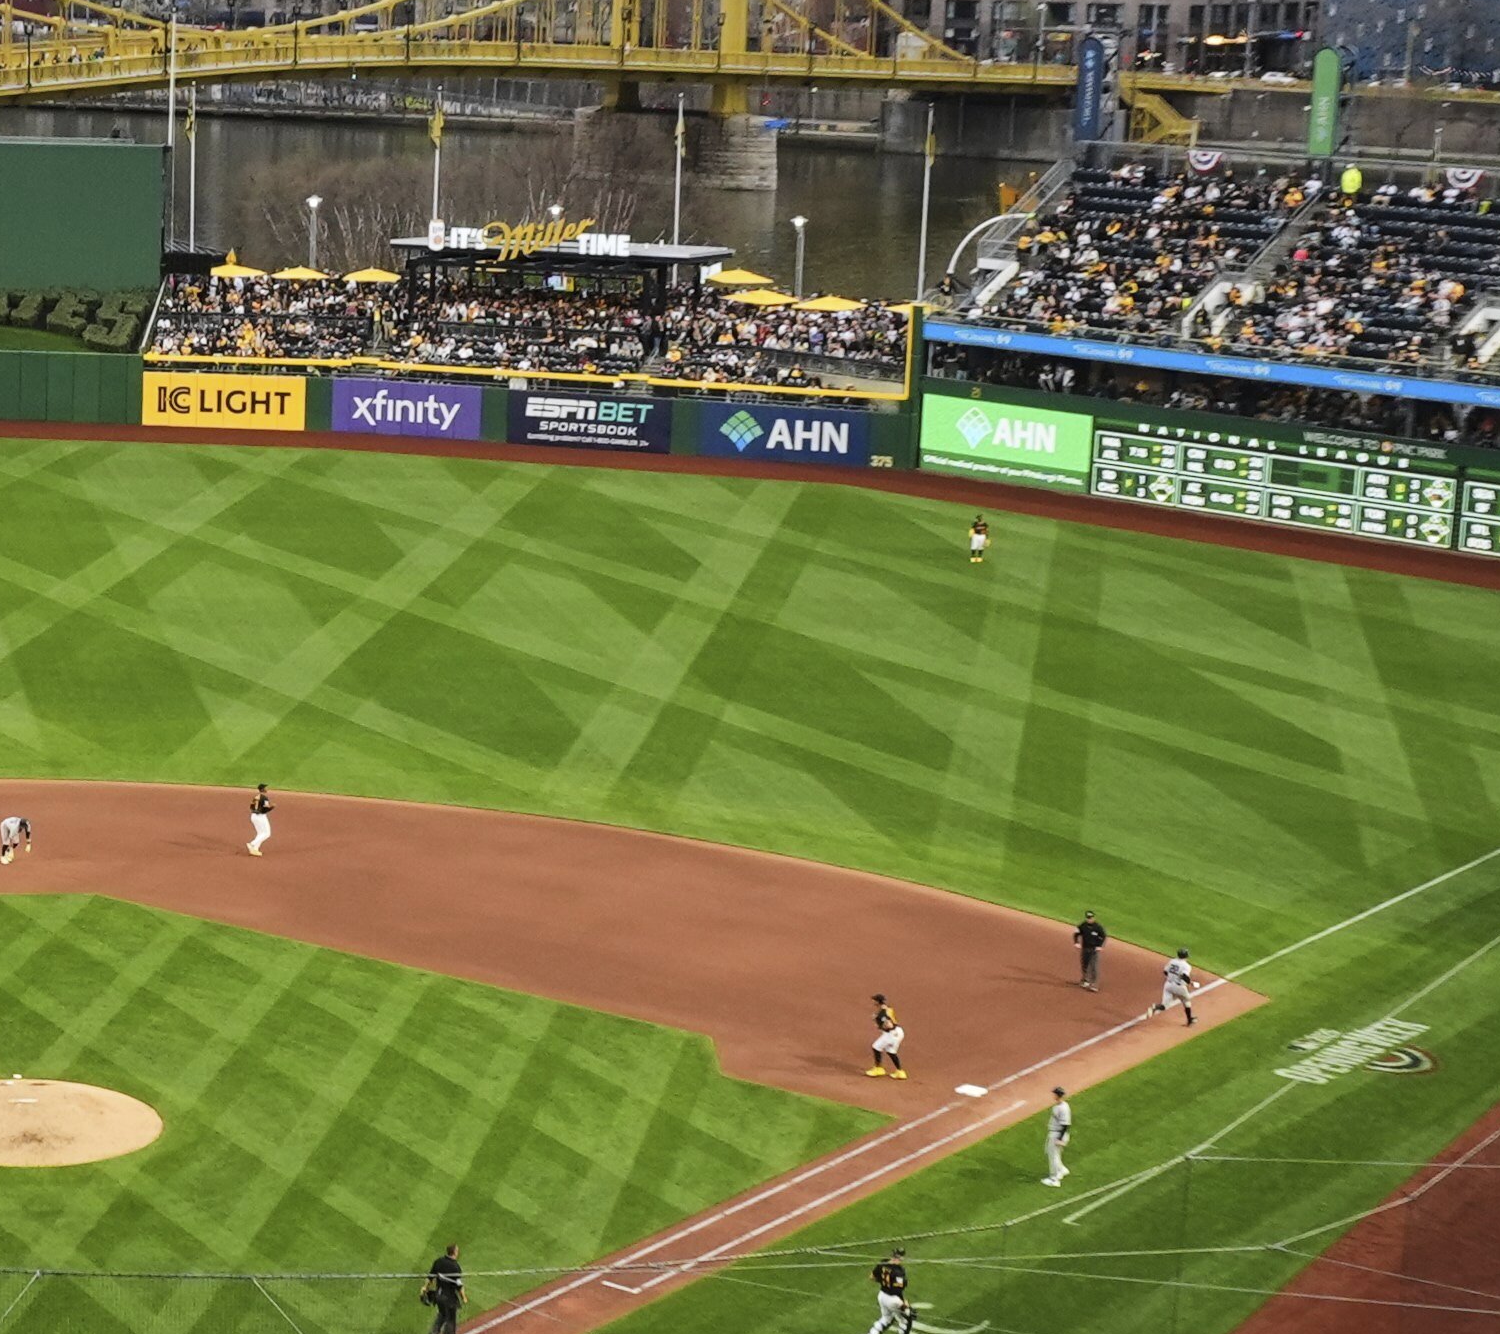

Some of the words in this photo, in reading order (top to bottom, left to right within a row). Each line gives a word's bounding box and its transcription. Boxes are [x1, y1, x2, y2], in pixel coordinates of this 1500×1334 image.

[448, 226, 489, 250] IT'S
[484, 216, 597, 265] Miller
[577, 232, 631, 258] TIME
[199, 389, 291, 417] LIGHT
[352, 388, 462, 431] xfinity
[525, 396, 597, 421] ESPN
[597, 401, 654, 425] BET
[539, 420, 638, 437] SPORTSBOOK
[766, 418, 850, 454] AHN
[992, 417, 1056, 453] AHN
[1138, 423, 1277, 451] NATIONAL
[1299, 445, 1410, 468] LEAGUE
